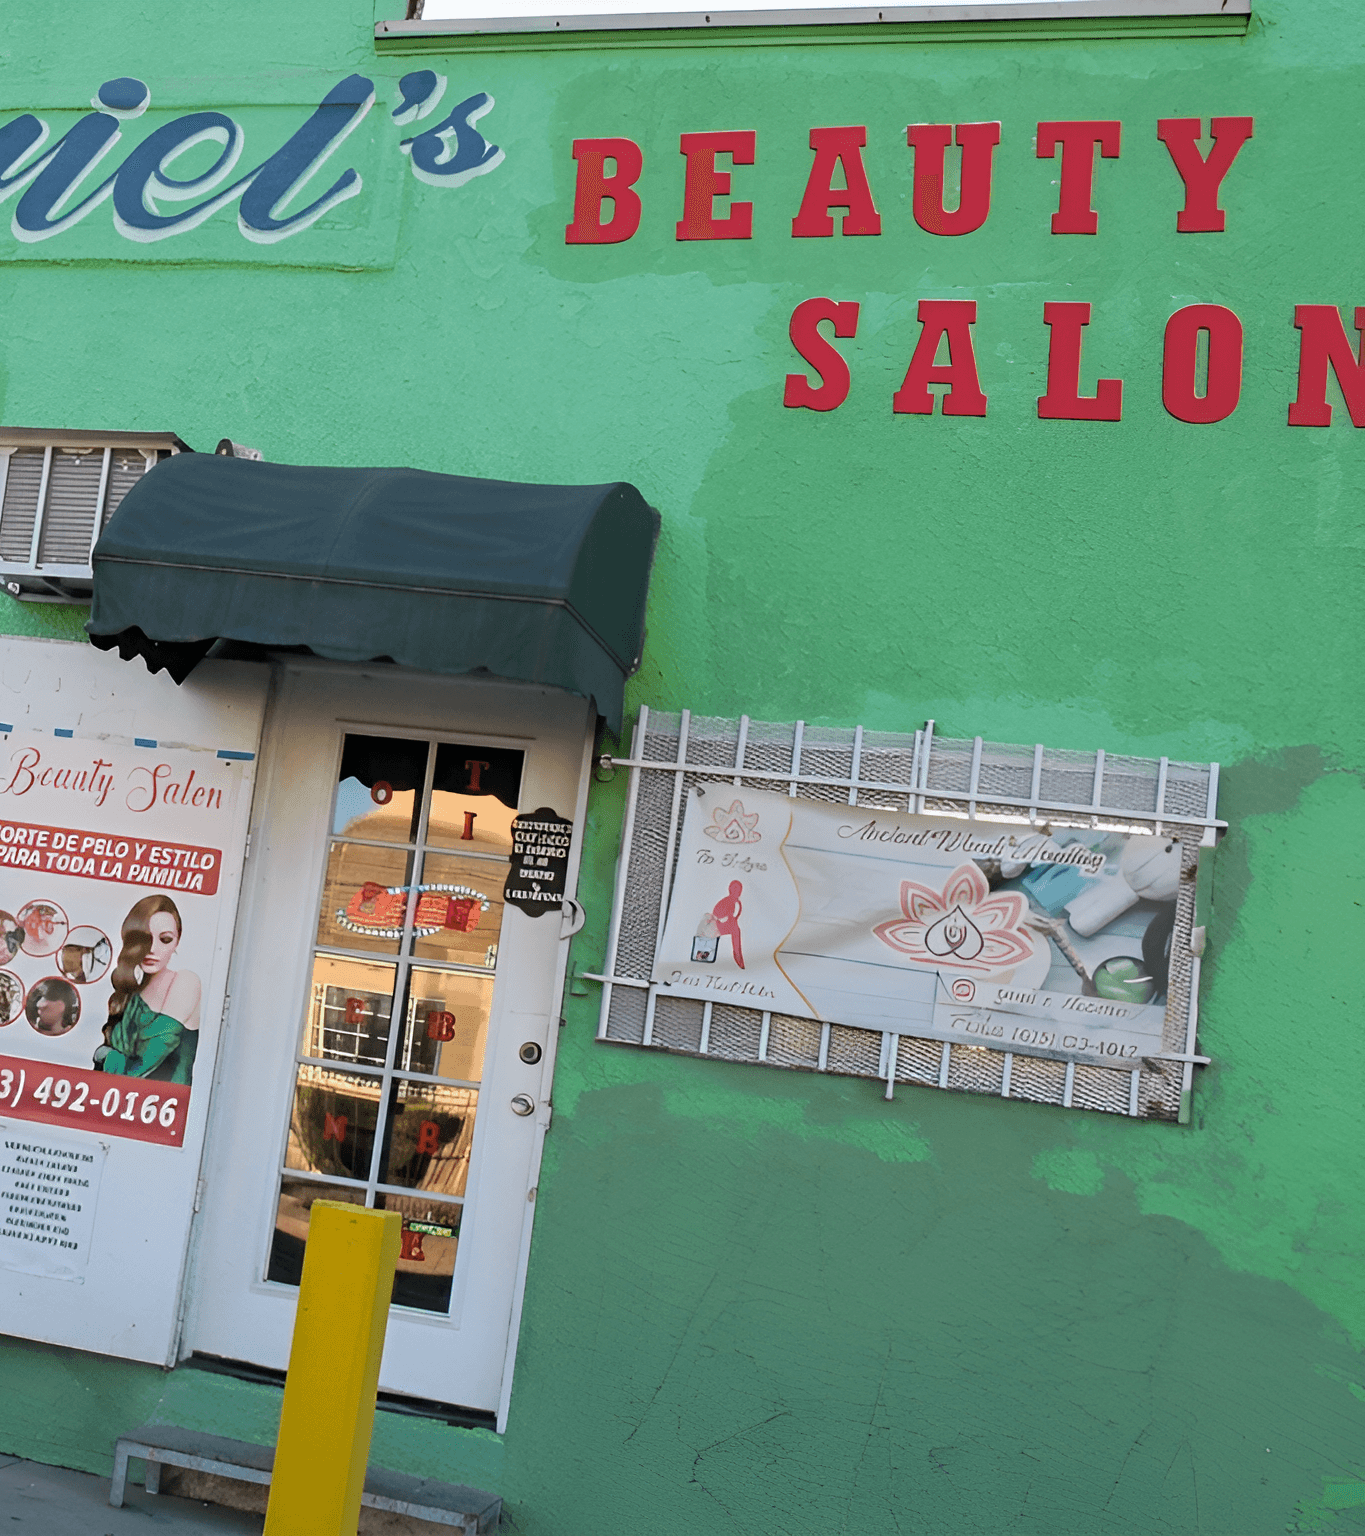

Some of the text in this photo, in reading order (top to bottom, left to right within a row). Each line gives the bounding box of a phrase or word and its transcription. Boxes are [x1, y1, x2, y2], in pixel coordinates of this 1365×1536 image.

[565, 117, 1253, 244] BEAUTY
[784, 297, 1365, 428] SALON
[46, 852, 95, 875] TODA
[99, 860, 122, 879] LA
[52, 832, 79, 852] DE
[135, 842, 147, 860] Y
[149, 846, 215, 870] ESTILO
[33, 1076, 178, 1128] 492-0166
